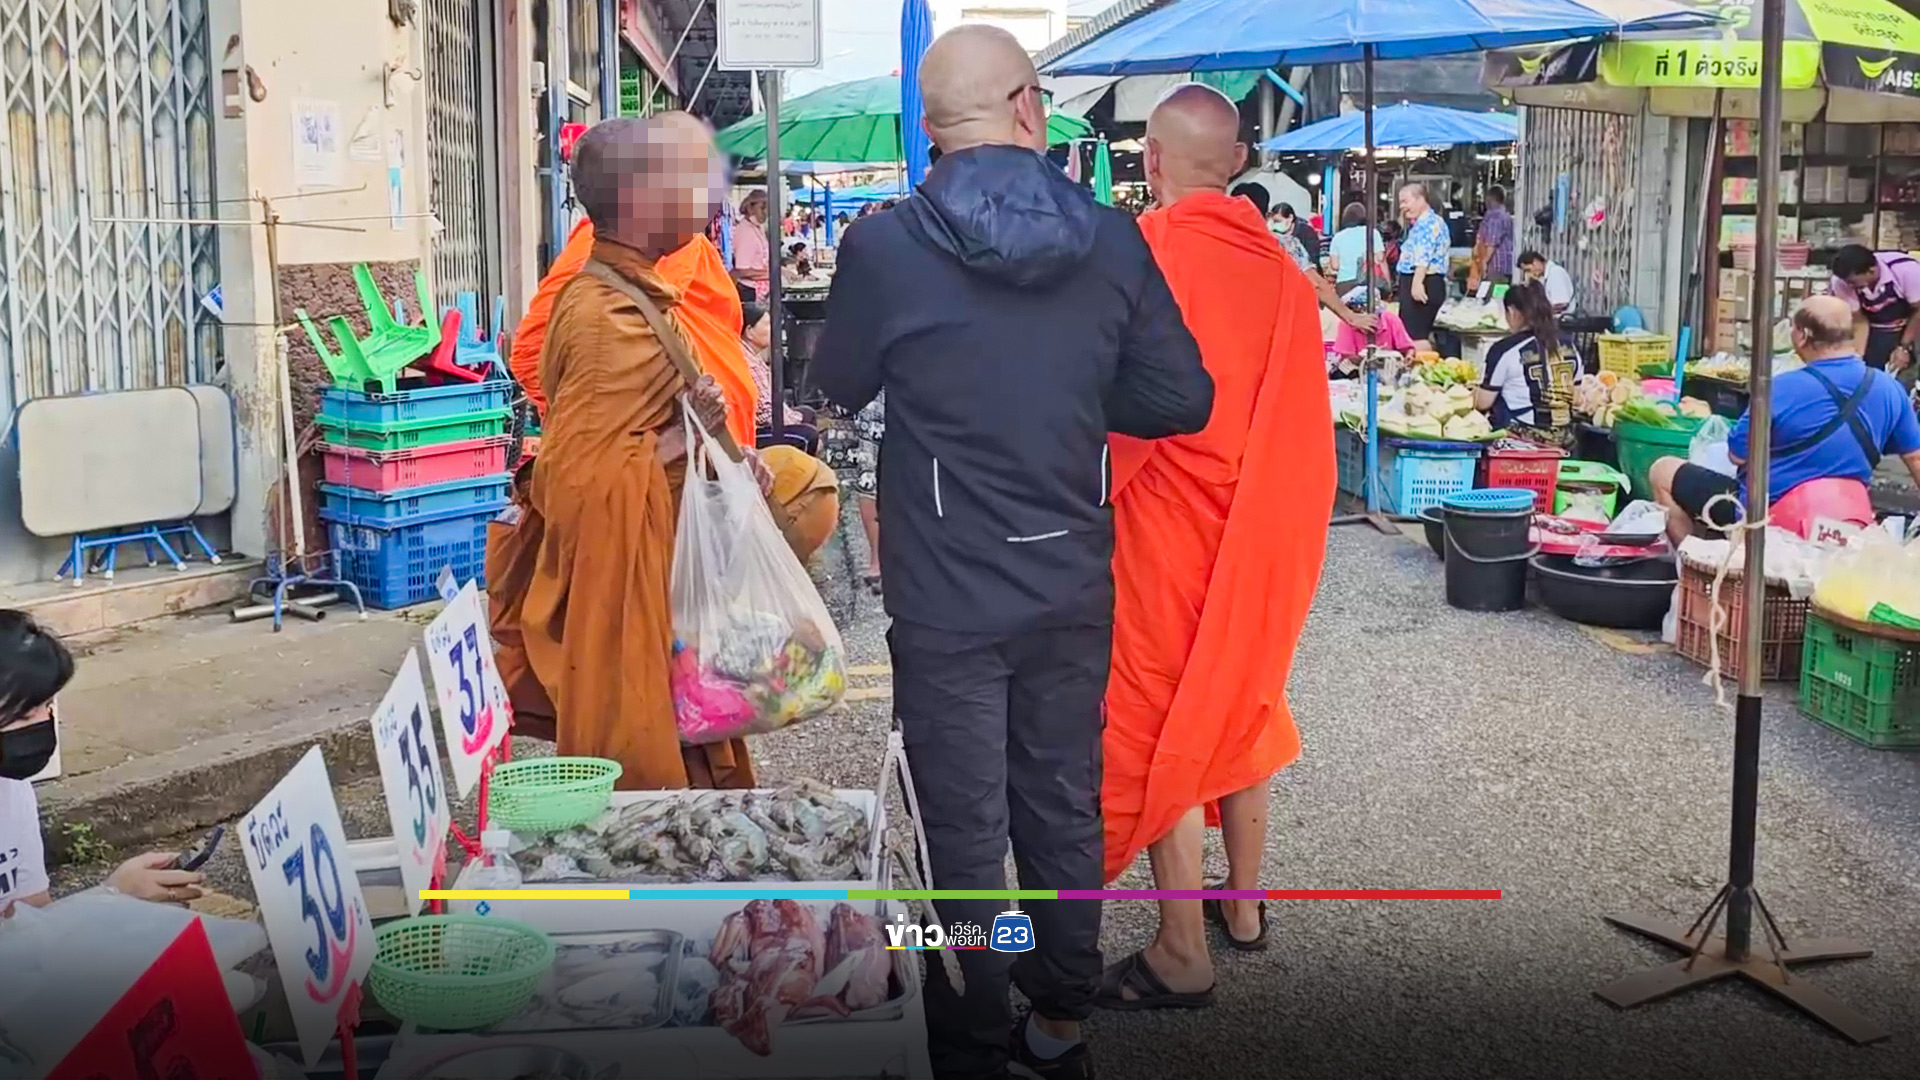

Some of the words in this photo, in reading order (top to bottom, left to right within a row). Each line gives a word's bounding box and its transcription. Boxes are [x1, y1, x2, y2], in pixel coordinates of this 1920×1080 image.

[1655, 49, 1669, 76] ที่
[1677, 49, 1687, 76] 1
[1695, 54, 1758, 76] ตัวจริง
[449, 623, 485, 736] 37
[399, 702, 436, 849] 35
[282, 823, 346, 983] 30
